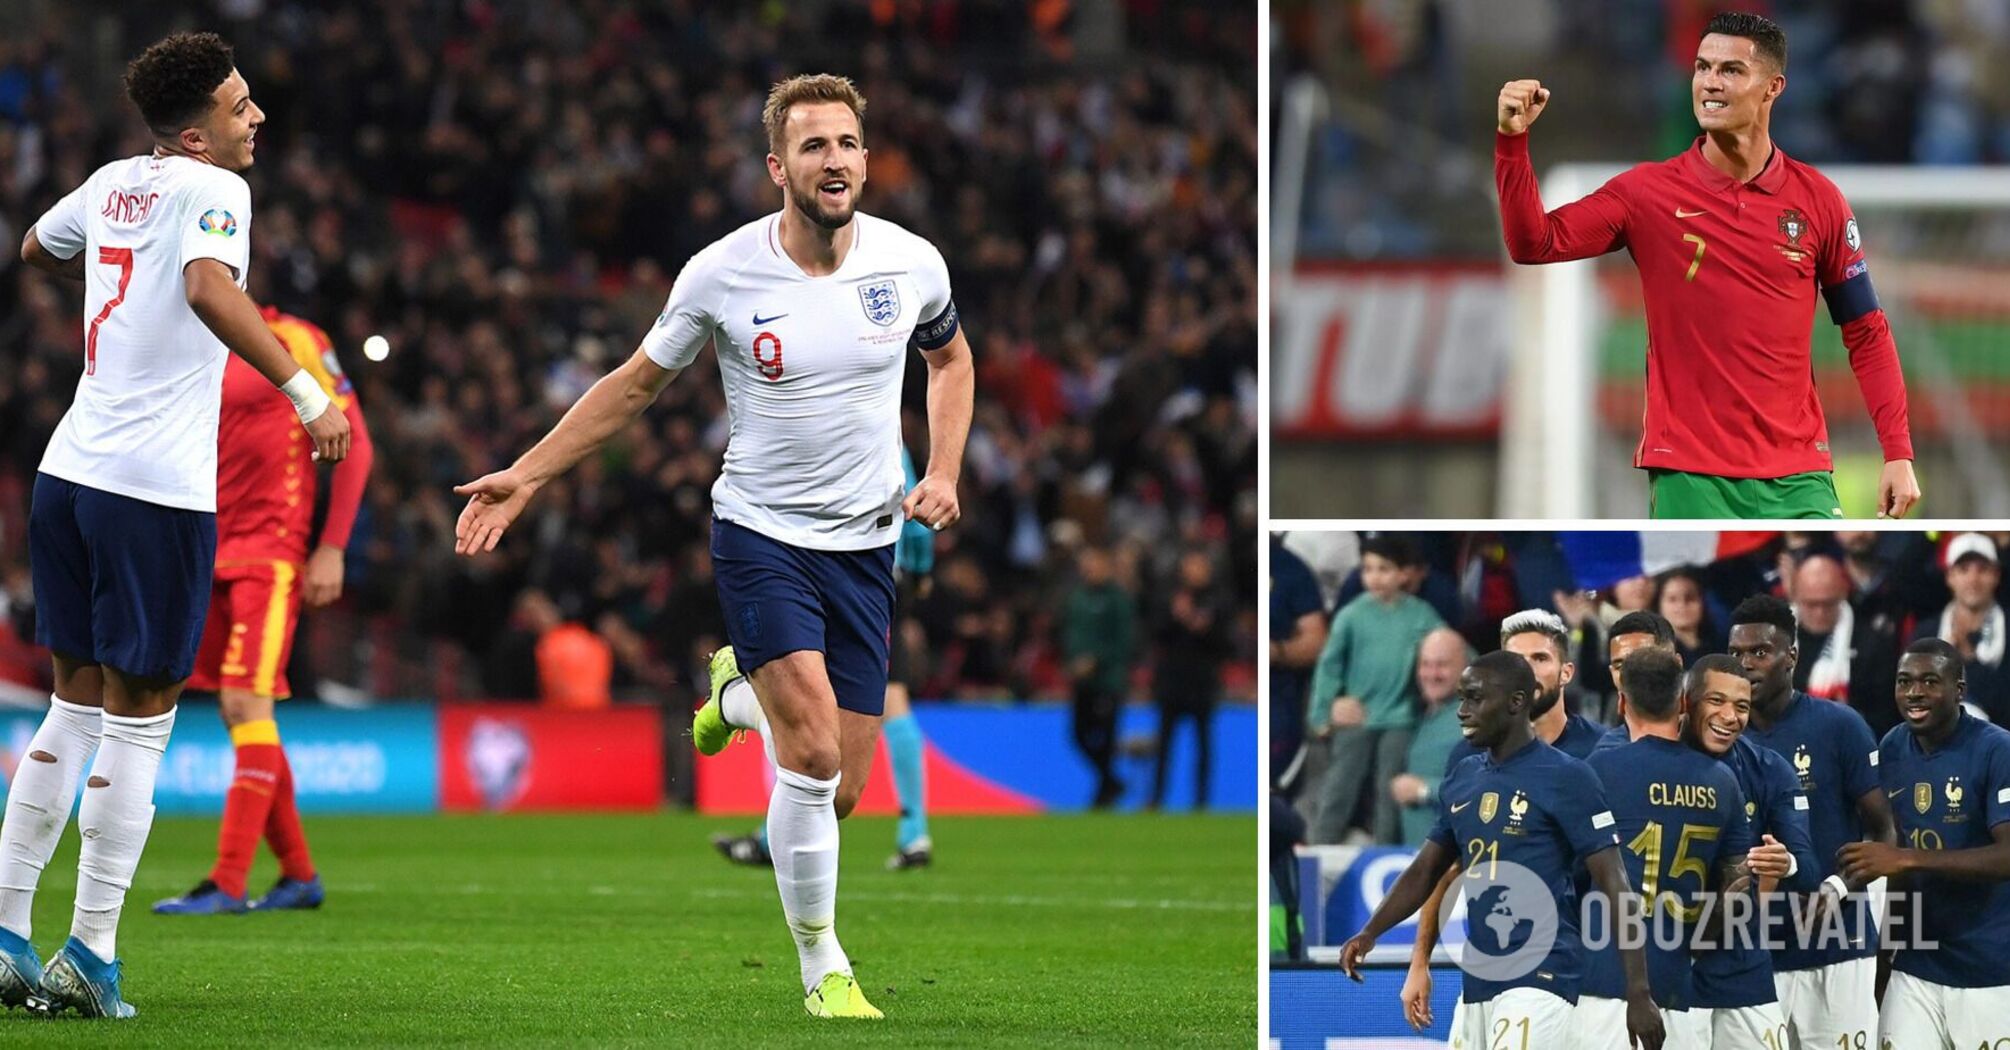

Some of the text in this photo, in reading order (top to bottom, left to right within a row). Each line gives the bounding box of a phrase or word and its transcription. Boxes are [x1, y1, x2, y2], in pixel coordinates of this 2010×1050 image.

[1683, 233, 1706, 282] 7
[86, 246, 133, 376] 7
[752, 331, 784, 381] 9
[1649, 782, 1718, 810] CLAUSS
[1466, 838, 1499, 881] 21
[1627, 819, 1721, 923] 15
[1493, 1016, 1530, 1050] 21
